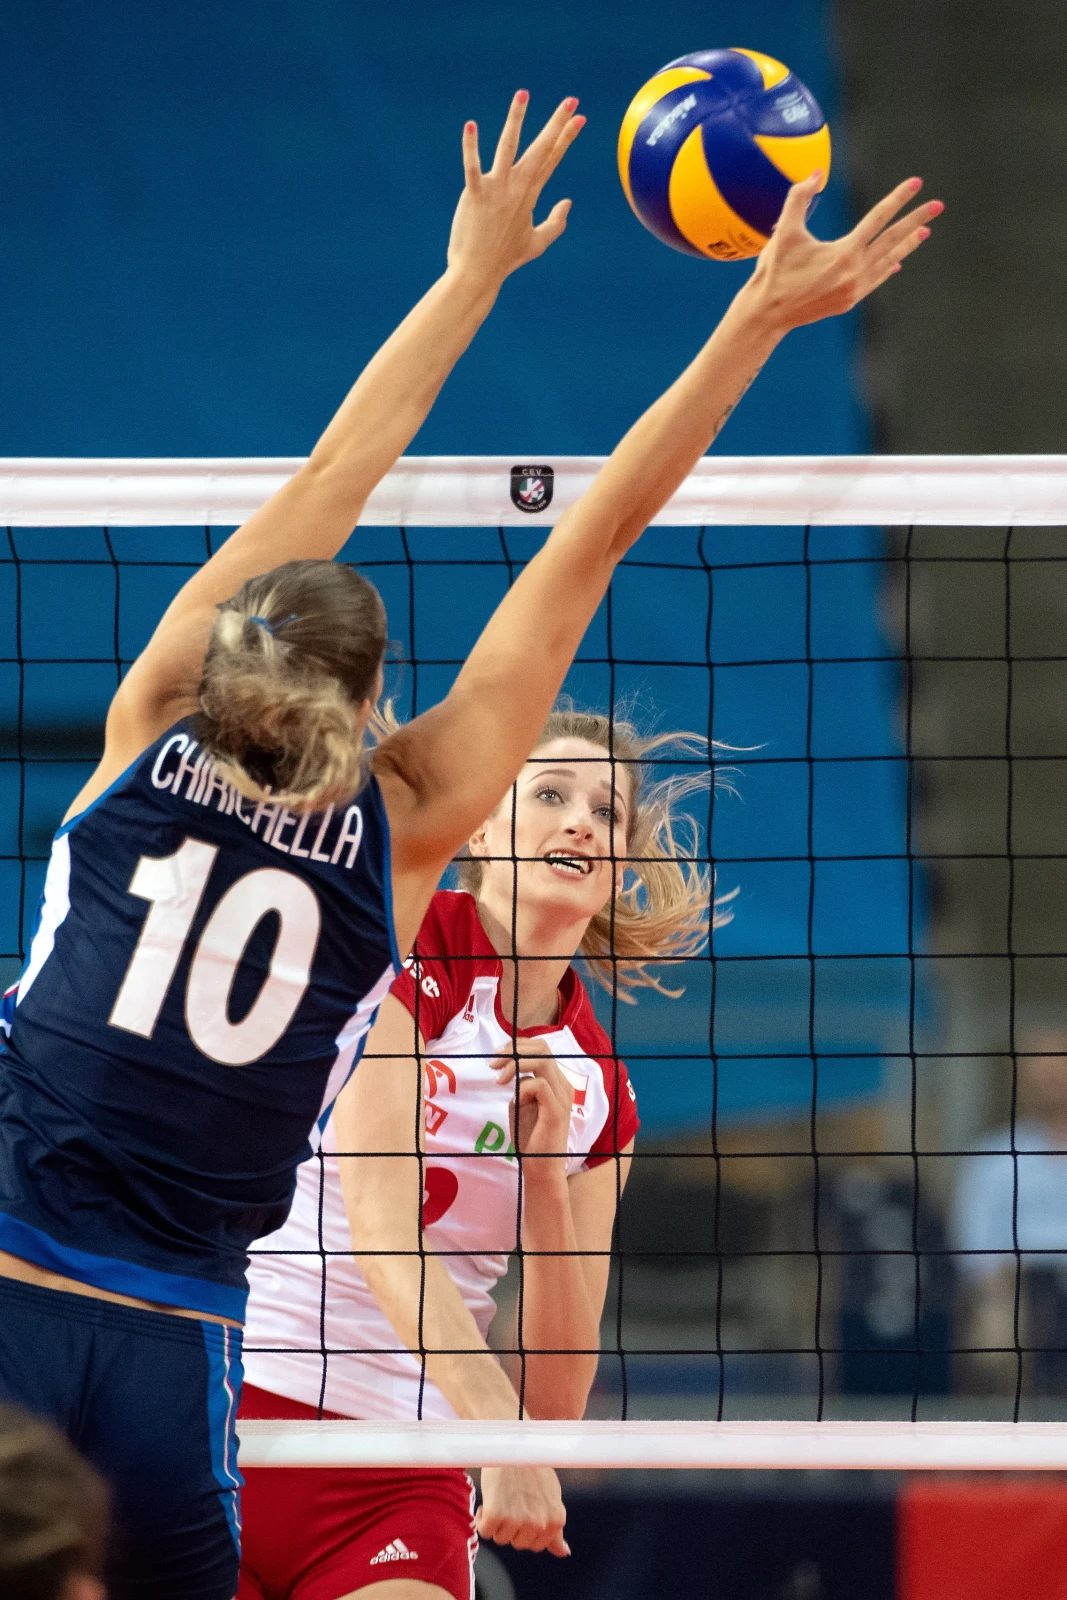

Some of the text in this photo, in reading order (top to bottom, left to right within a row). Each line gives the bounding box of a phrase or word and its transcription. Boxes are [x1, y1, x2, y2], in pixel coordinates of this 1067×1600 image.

[522, 468, 542, 476] CEV
[108, 836, 321, 1067] 10
[369, 1550, 419, 1566] adidas
